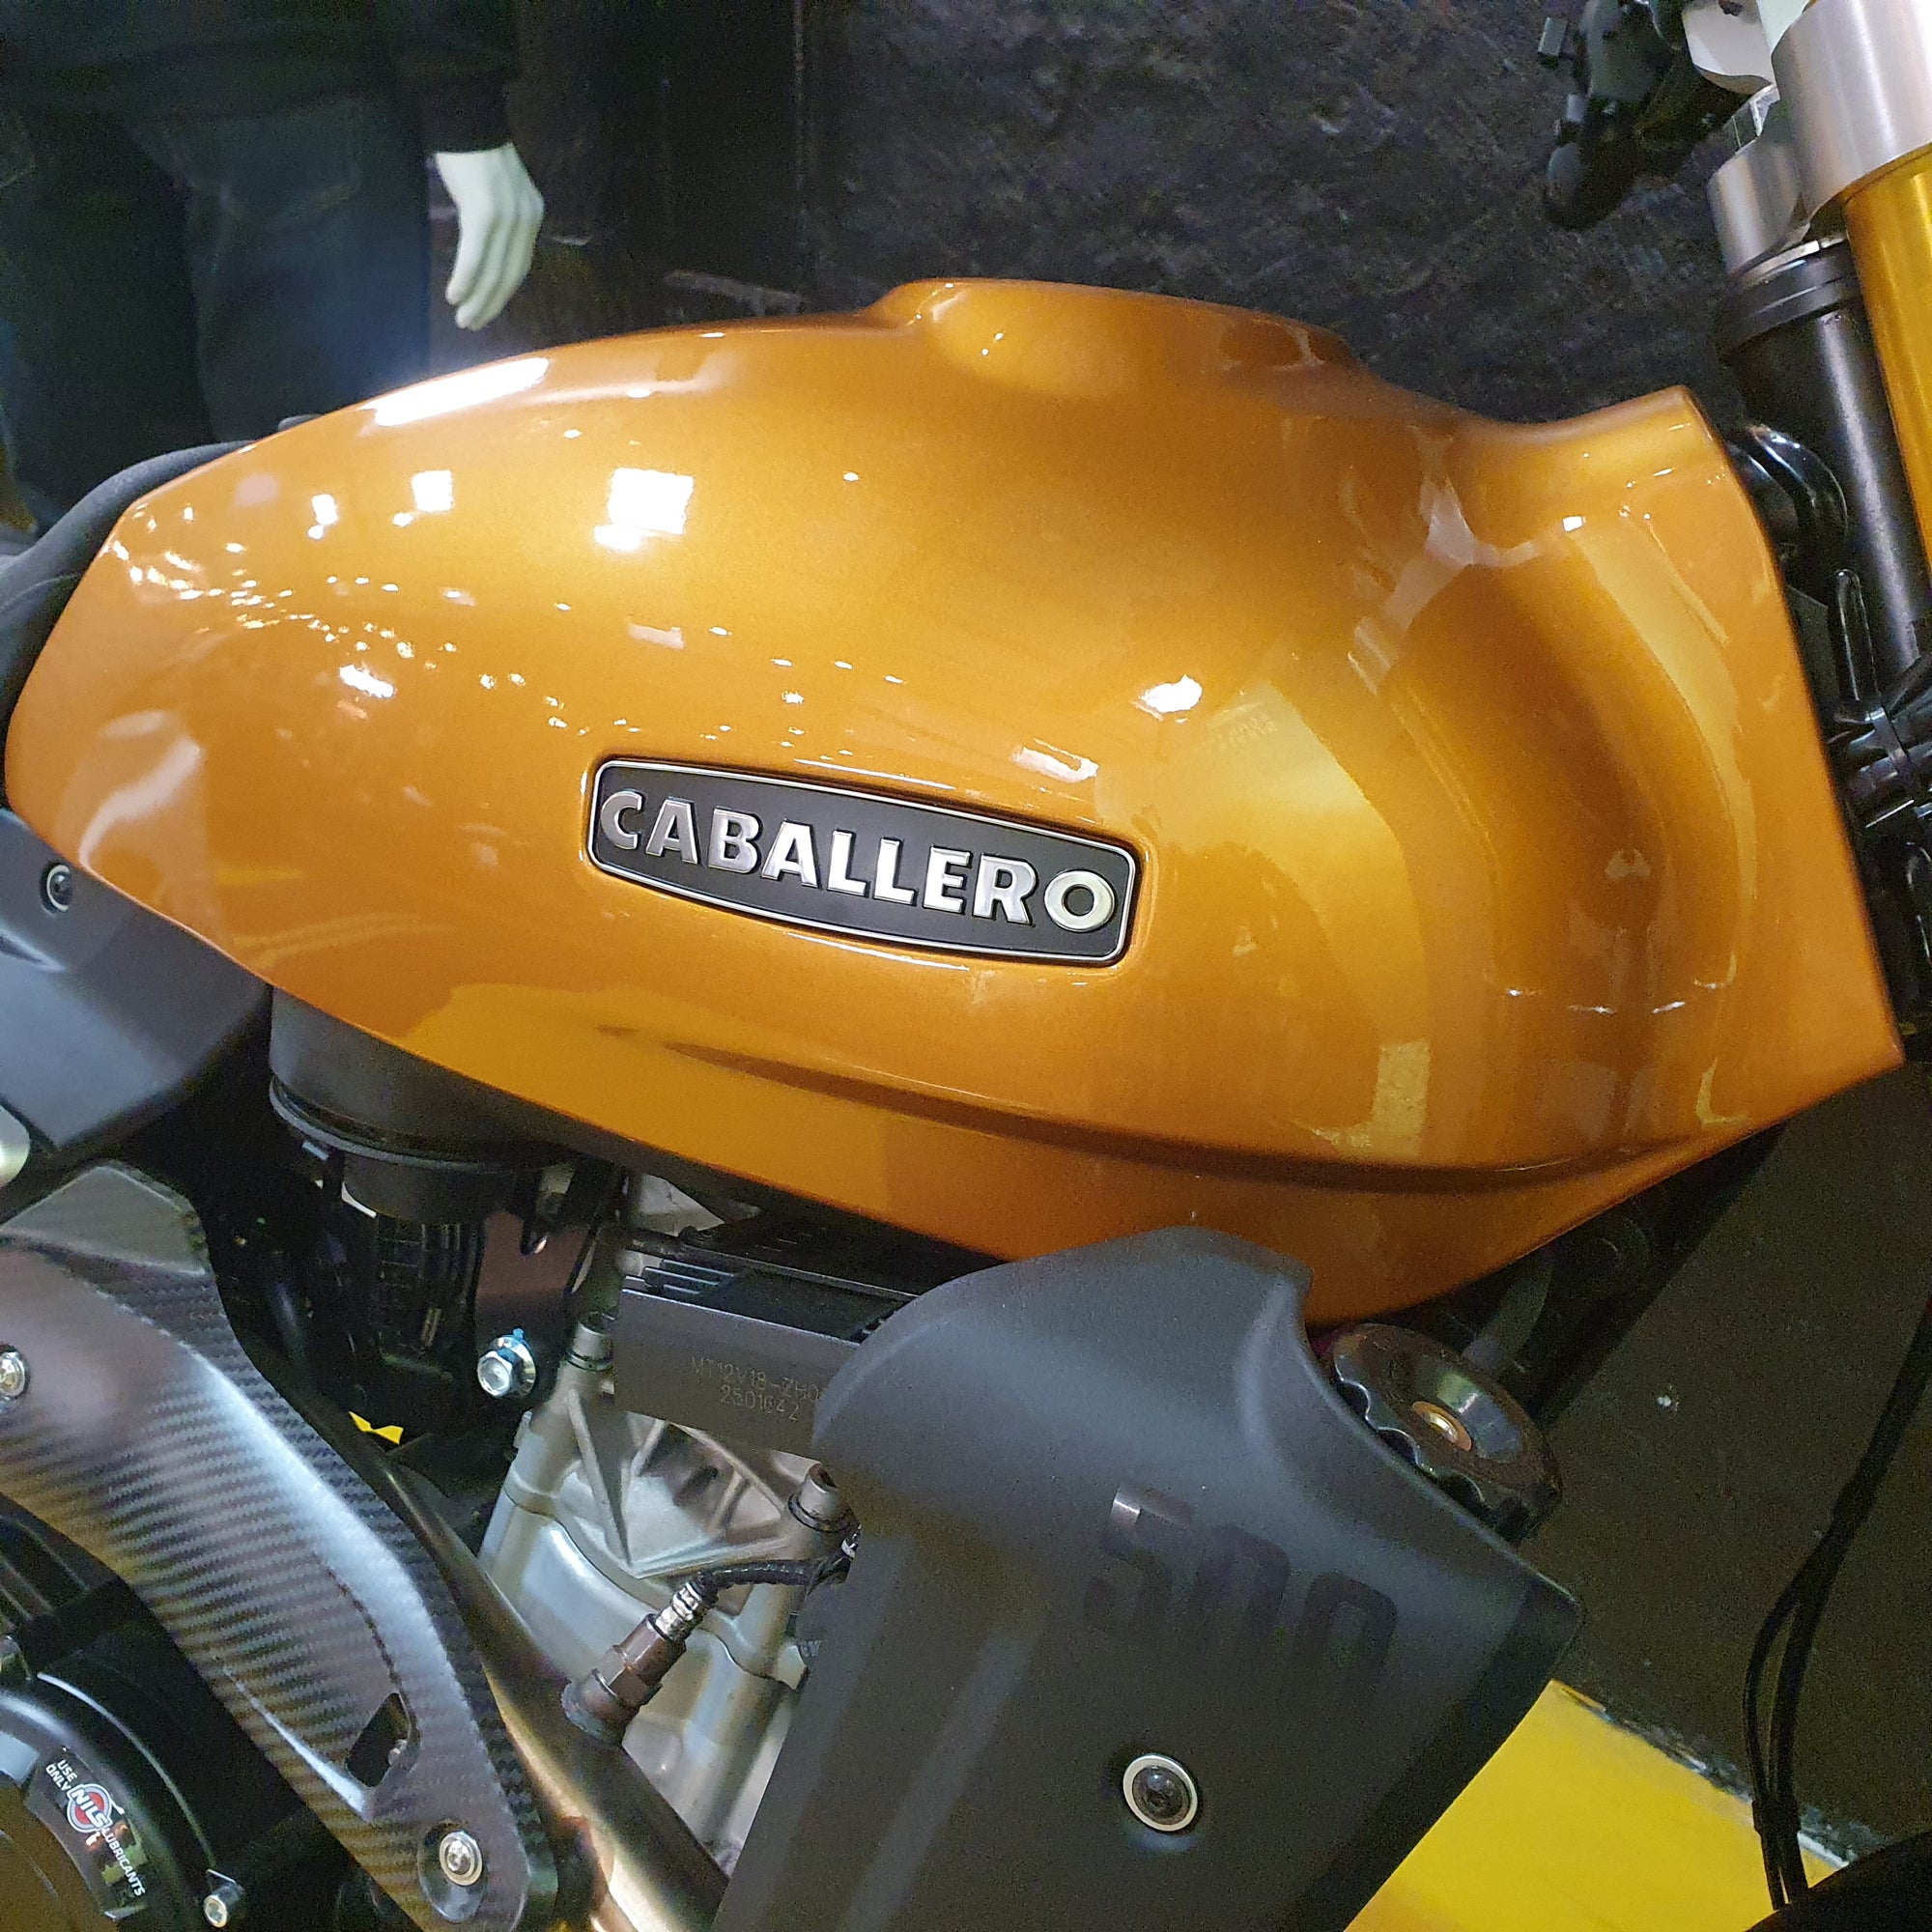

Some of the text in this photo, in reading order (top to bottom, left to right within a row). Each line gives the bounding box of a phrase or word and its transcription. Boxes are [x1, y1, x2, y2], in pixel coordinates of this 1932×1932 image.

[600, 789, 1116, 932] CABALLERO
[45, 1762, 72, 1792] ONLY
[57, 1758, 78, 1782] USE
[71, 1788, 109, 1829] NILS
[101, 1828, 146, 1896] LUBRICANTS
